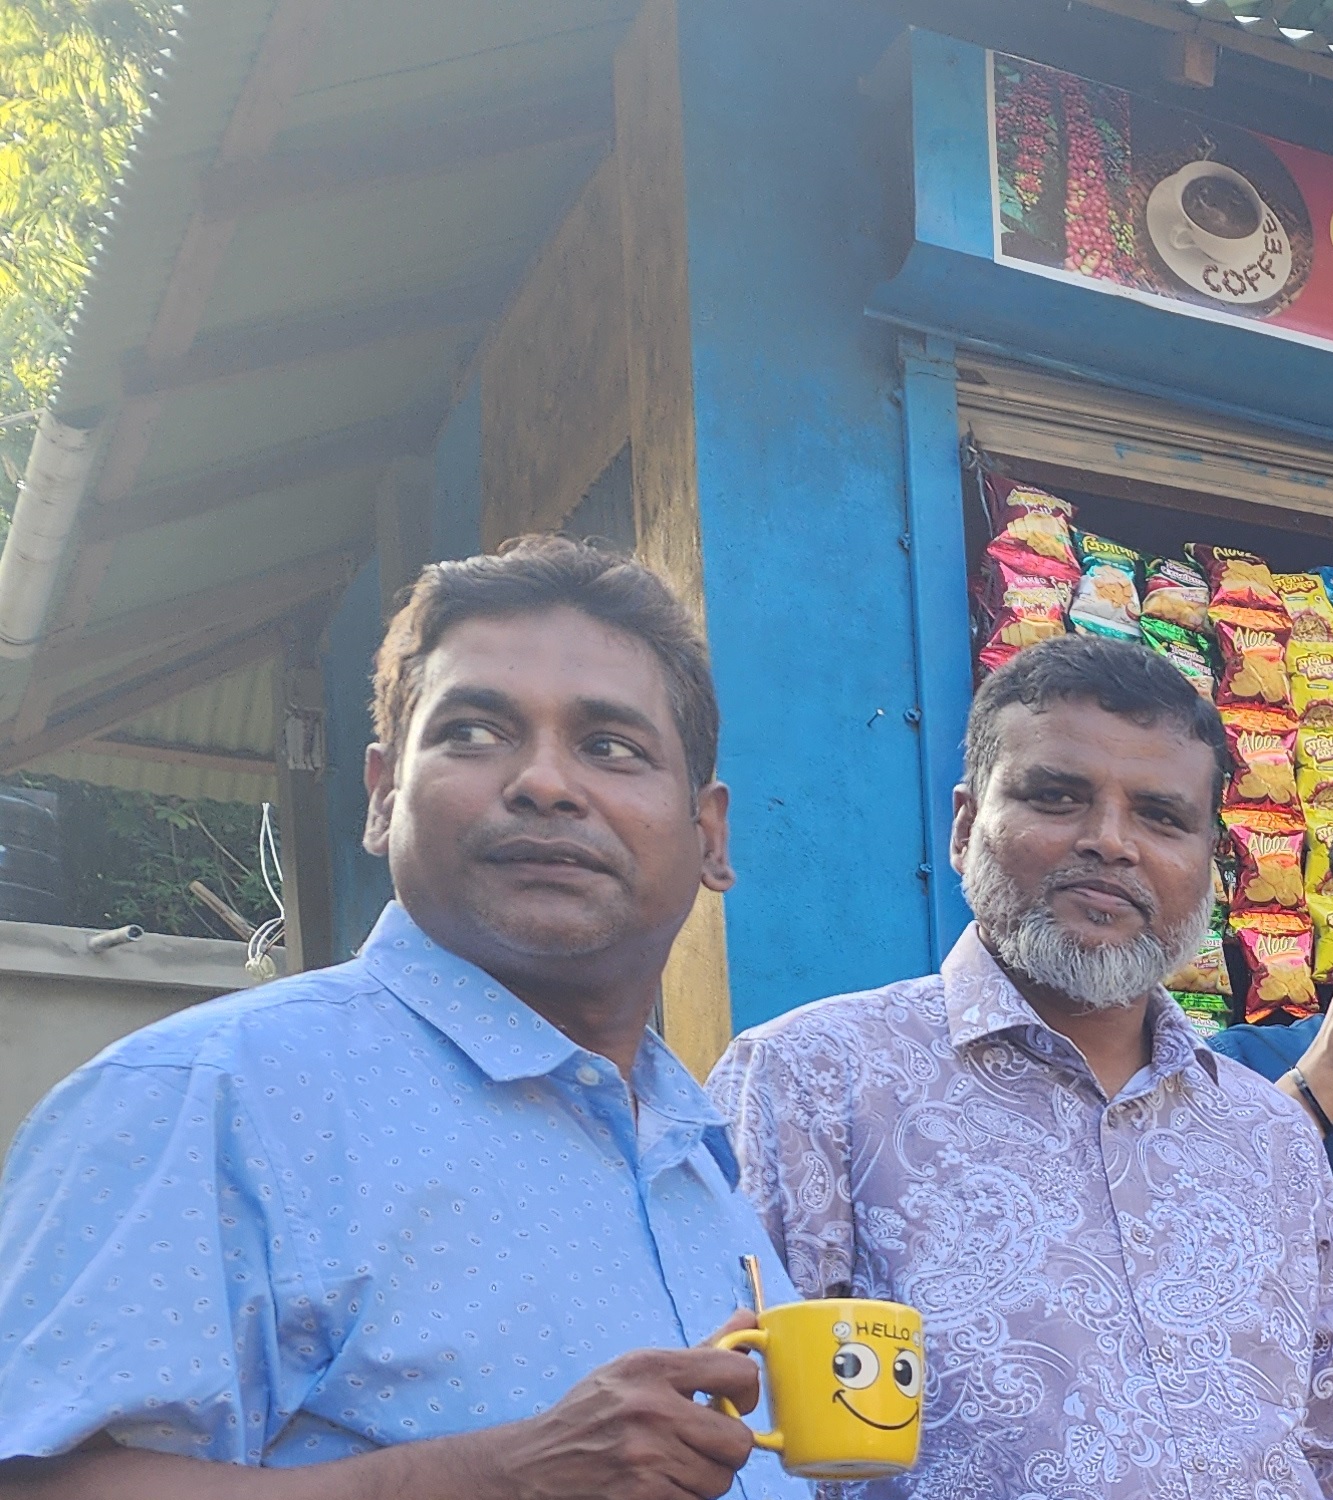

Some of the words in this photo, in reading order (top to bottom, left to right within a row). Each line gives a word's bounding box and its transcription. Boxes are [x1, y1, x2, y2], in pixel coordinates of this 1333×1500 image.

[1203, 212, 1283, 297] COFFEE
[1250, 833, 1290, 854] Alooz
[855, 1320, 910, 1342] HELLO
